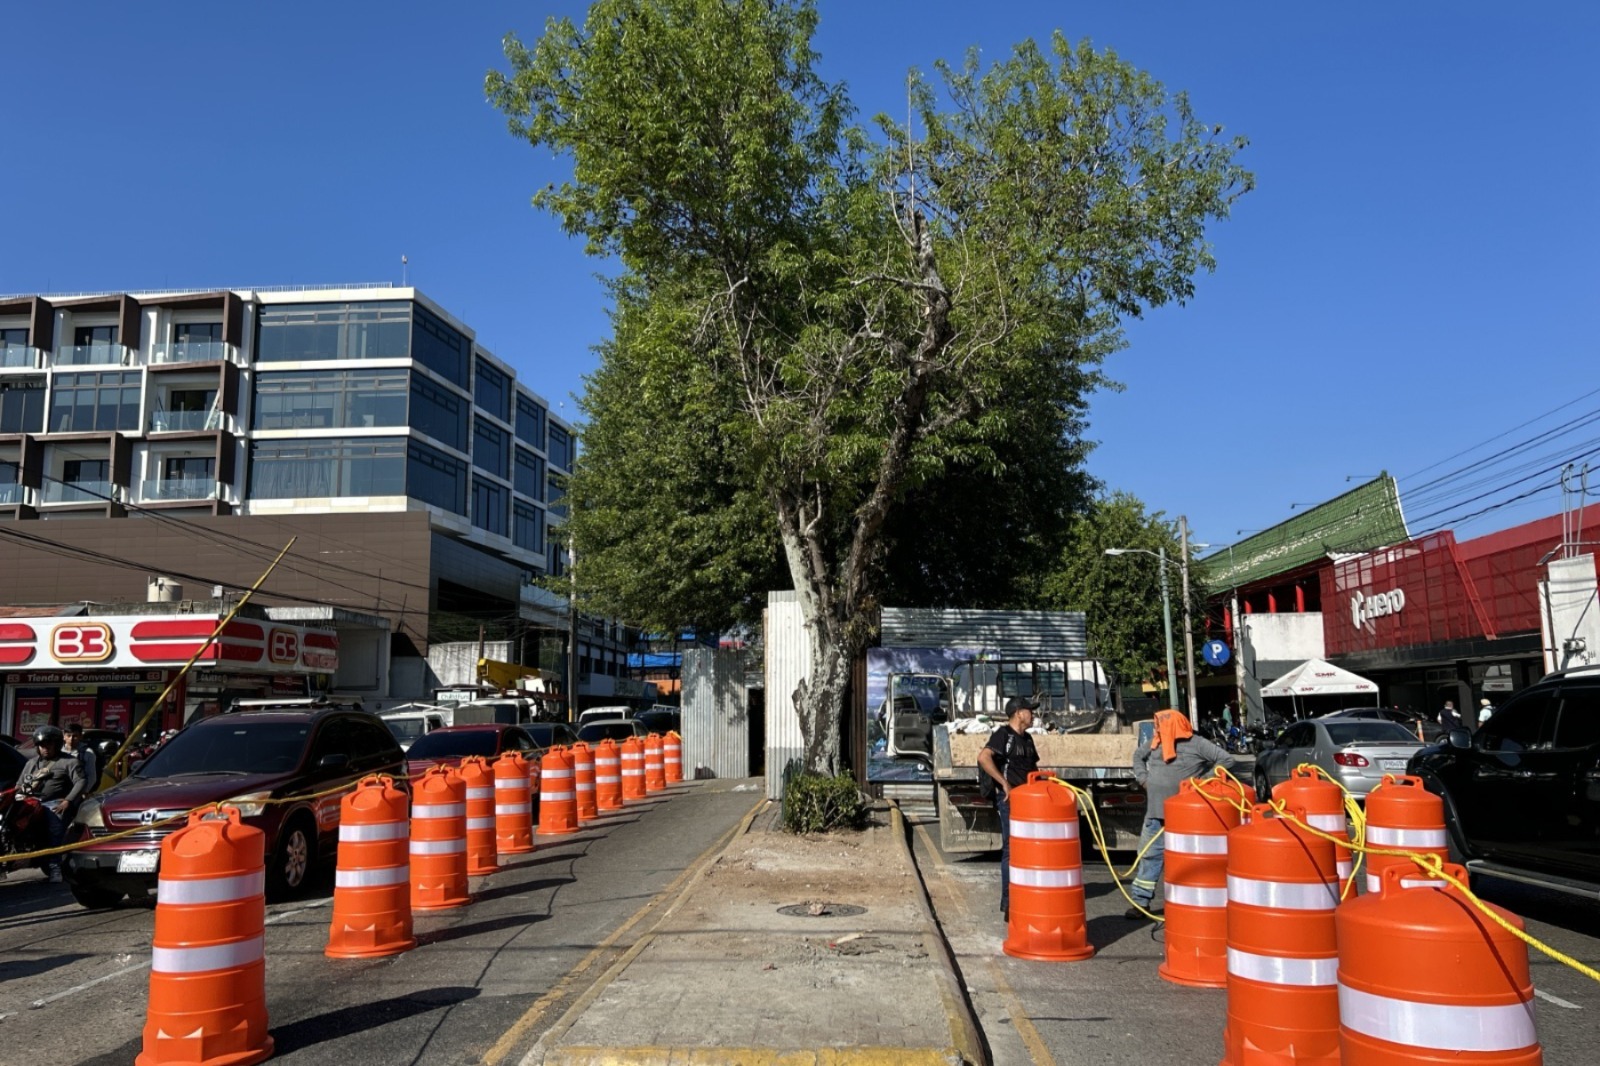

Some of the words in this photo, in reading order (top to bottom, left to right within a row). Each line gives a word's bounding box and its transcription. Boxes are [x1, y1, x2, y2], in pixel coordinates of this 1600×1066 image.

[1366, 588, 1406, 619] Hero
[1211, 643, 1223, 659] P
[27, 674, 59, 682] Tienda
[61, 673, 74, 682] de
[76, 672, 140, 682] Conveniencia
